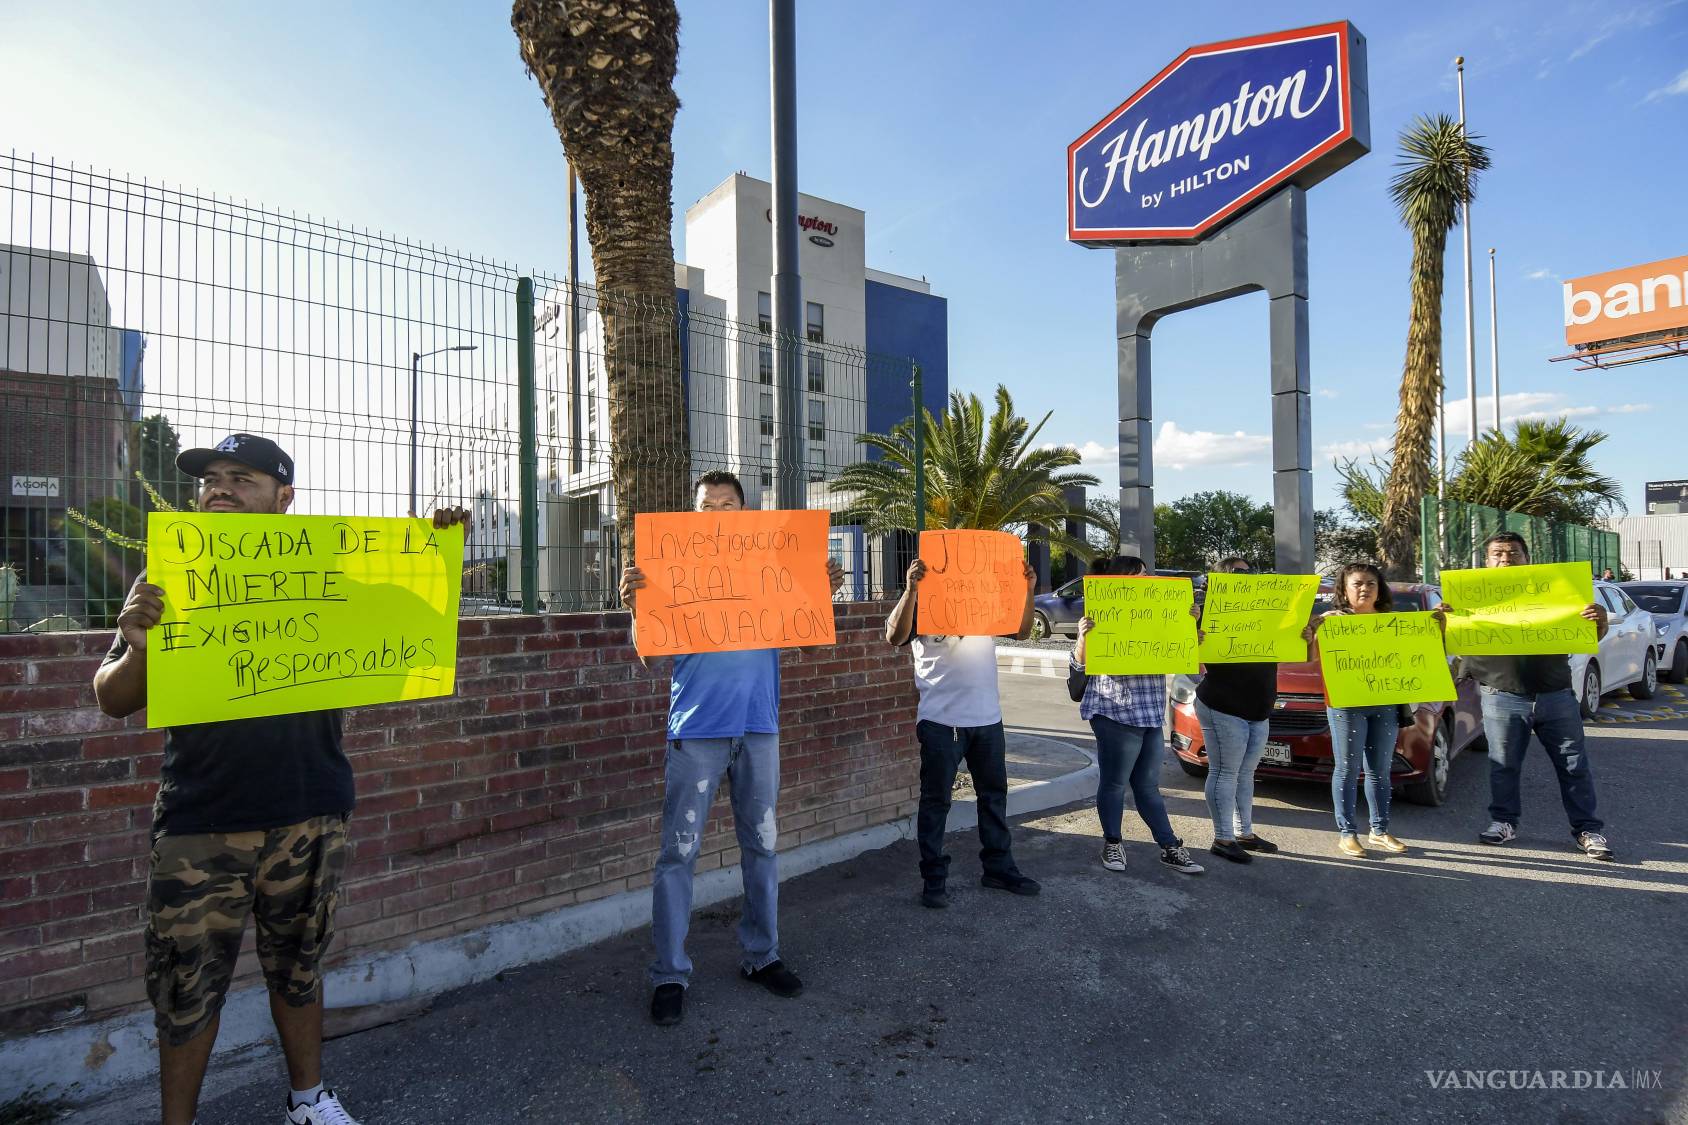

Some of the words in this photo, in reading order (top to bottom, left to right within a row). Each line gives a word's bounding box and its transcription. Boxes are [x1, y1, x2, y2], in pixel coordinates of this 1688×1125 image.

[1079, 65, 1333, 208] Hampton
[1141, 190, 1164, 209] by
[1170, 155, 1251, 198] HILTON
[1563, 271, 1688, 327] ban
[163, 520, 313, 564] DISCADA
[332, 523, 382, 555] DE
[400, 524, 439, 556] LA
[185, 564, 345, 612] MUERTE
[667, 565, 748, 604] REAL
[160, 612, 319, 652] EXIGIMOS
[1451, 624, 1513, 648] VIDAS
[228, 636, 436, 696] Responsables
[1410, 653, 1426, 671] en
